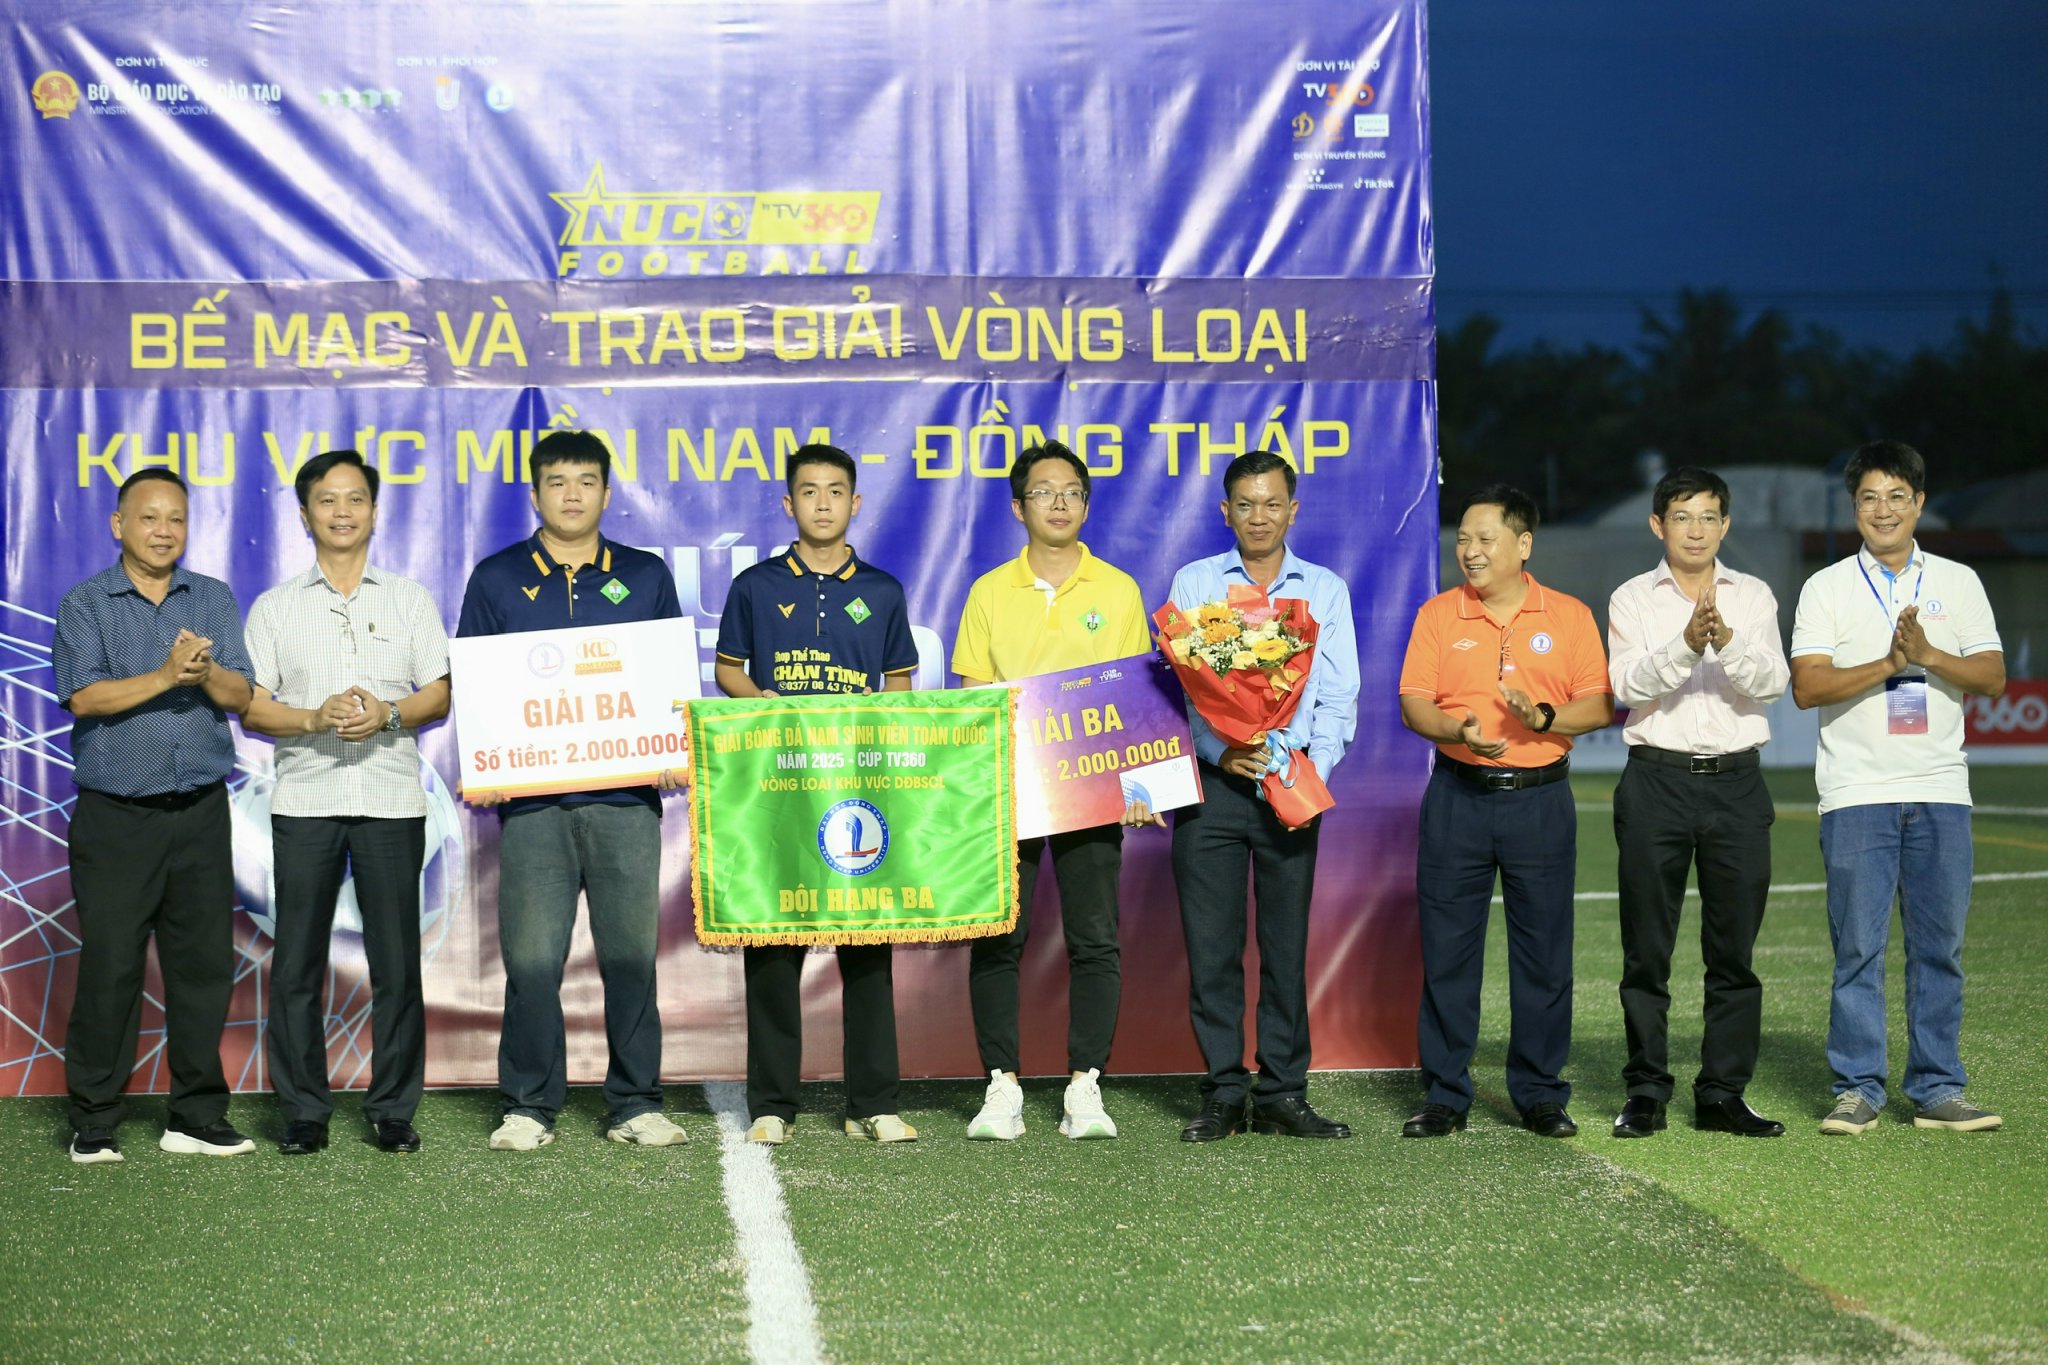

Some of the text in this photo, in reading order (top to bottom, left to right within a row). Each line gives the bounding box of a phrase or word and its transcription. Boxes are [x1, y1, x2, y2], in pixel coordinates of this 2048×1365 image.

[116, 57, 142, 67] ĐƠN
[143, 57, 156, 69] VỊ
[1297, 61, 1322, 71] ĐƠN
[1324, 61, 1337, 72] VỊ
[87, 80, 110, 104] BỘ
[156, 83, 189, 105] DỤC
[252, 83, 282, 105] TẠO
[1302, 83, 1375, 107] TV30
[153, 105, 209, 115] DUCATION
[1357, 149, 1386, 160] THÔNG
[558, 251, 867, 276] FOOTBALL
[130, 288, 231, 369] BẾ
[253, 311, 412, 379] MẠC
[435, 295, 529, 367] VÀ
[772, 285, 904, 361] GIẢI
[925, 291, 1125, 362] VÒNG
[1151, 308, 1308, 374] LOẠI
[77, 431, 236, 488] KHU
[1149, 405, 1350, 477] THÁP
[809, 649, 831, 662] Thao
[787, 681, 810, 691] 0377
[827, 682, 840, 692] 43
[824, 664, 868, 688] TÌNH
[523, 688, 637, 729] GIẢI BA
[1962, 693, 2048, 733] 360
[713, 718, 989, 755] GIẢI BÓNG ĐÁ NAM SINH VIÊN TOÀN QUỐC
[1031, 703, 1124, 746] IẢI BA
[474, 746, 502, 772] Số
[508, 743, 558, 769] tiền:
[776, 750, 808, 770] NĂM
[811, 753, 845, 769] 2025
[857, 748, 883, 767] CÚP
[885, 751, 927, 767] TV360
[1056, 735, 1182, 781] 2.000.000đ
[760, 775, 799, 792] VÒNG
[801, 777, 832, 794] LOẠI
[835, 776, 861, 790] KHU
[865, 774, 891, 793] VỰC
[779, 882, 935, 919] ĐỘI HẠNG BA
